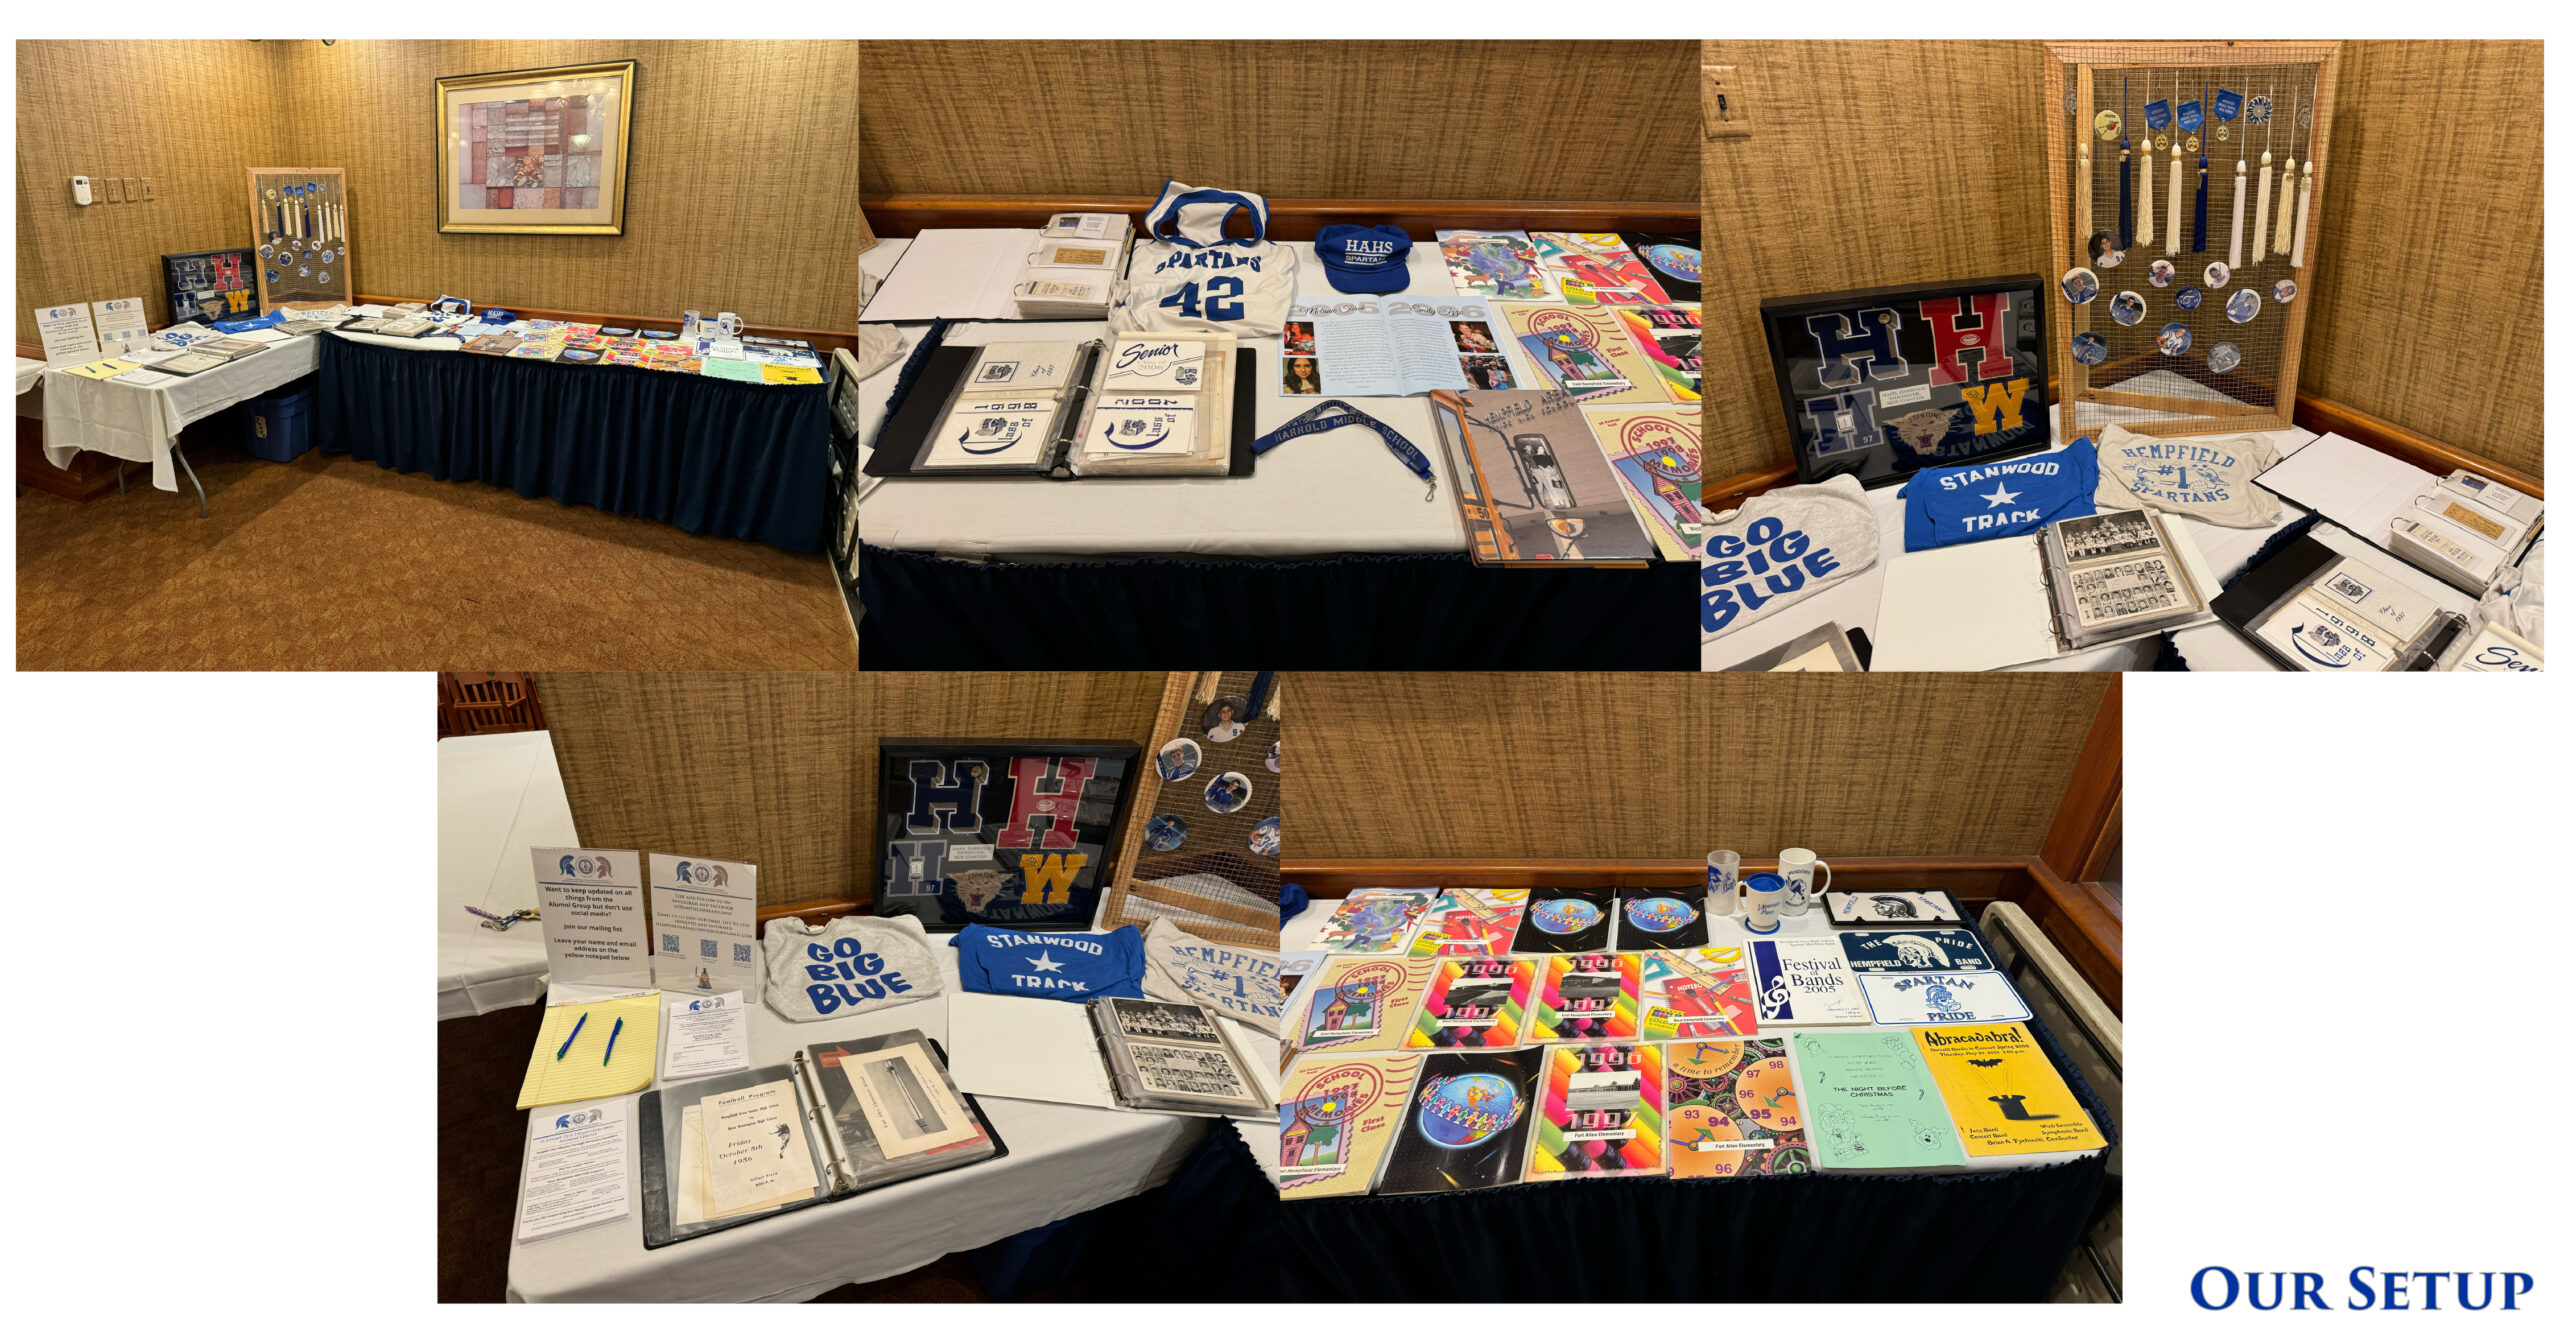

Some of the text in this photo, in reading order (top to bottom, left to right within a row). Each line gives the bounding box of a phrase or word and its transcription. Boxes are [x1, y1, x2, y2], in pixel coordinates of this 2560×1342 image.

[1345, 239, 1393, 254] HAHS
[211, 253, 243, 291] H
[225, 289, 250, 314] W
[1159, 275, 1245, 322] 42
[1537, 314, 1570, 326] SCHOOL
[1806, 305, 1910, 390] H
[1918, 292, 2015, 388] H
[1116, 342, 1180, 369] Senior
[1961, 377, 2030, 437] W
[1803, 387, 1886, 459] H
[1274, 415, 1419, 461] HARROLD MIDDLE SCHOOL
[1632, 424, 1672, 444] SCHOOL
[1645, 437, 1676, 451] 1997
[2121, 444, 2236, 469] HEMPFIELD
[1939, 461, 2060, 491] STANWOOD
[2158, 464, 2191, 490] #1
[2130, 482, 2231, 503] SPARTANS
[1477, 507, 1490, 519] 50
[1961, 507, 2041, 533] TRACK
[1706, 516, 1784, 559] GO
[1701, 530, 1811, 588] BIG
[1701, 547, 1841, 633] BLUE
[906, 759, 990, 836] H
[996, 756, 1099, 850] H
[887, 839, 948, 897] H
[1019, 853, 1089, 905] W
[571, 887, 586, 895] keep
[587, 888, 613, 896] updated
[571, 902, 591, 910] Group
[1917, 895, 1947, 914] SPARTANS
[588, 924, 612, 933] mailing
[807, 936, 862, 963] GO
[986, 933, 1104, 956] STANWOOD
[1860, 936, 1974, 951] THE PRIDE
[586, 953, 611, 961] notepad
[804, 952, 885, 981] BIG
[1782, 957, 1842, 971] Festival
[1850, 957, 1983, 968] HEMPFIELD BAND
[1011, 973, 1091, 992] TRACK
[1351, 966, 1391, 980] SCHOOL
[1790, 973, 1844, 987] Bands
[805, 971, 913, 1015] BLUE
[1804, 985, 1836, 994] 2005
[1893, 975, 1976, 992] SPARTAN
[1926, 1011, 1977, 1022] PRIDE
[1924, 1026, 2024, 1047] Abracadabra!
[1680, 1065, 1700, 1075] time
[1714, 1043, 1741, 1073] remember
[1768, 1060, 1784, 1069] 98
[1316, 1070, 1366, 1090] SCHOOL
[1746, 1069, 1761, 1079] 97
[718, 1089, 776, 1106] Football Program
[1323, 1082, 1360, 1097] 1997
[1738, 1089, 1755, 1099] 96
[1684, 1109, 1700, 1120] 93
[1707, 1116, 1730, 1128] 94
[1750, 1108, 1772, 1120] 95
[1780, 1116, 1797, 1127] 94
[728, 1138, 752, 1149] Friday
[719, 1147, 748, 1160] October
[733, 1156, 753, 1166] 1956
[1715, 1163, 1733, 1175] 96
